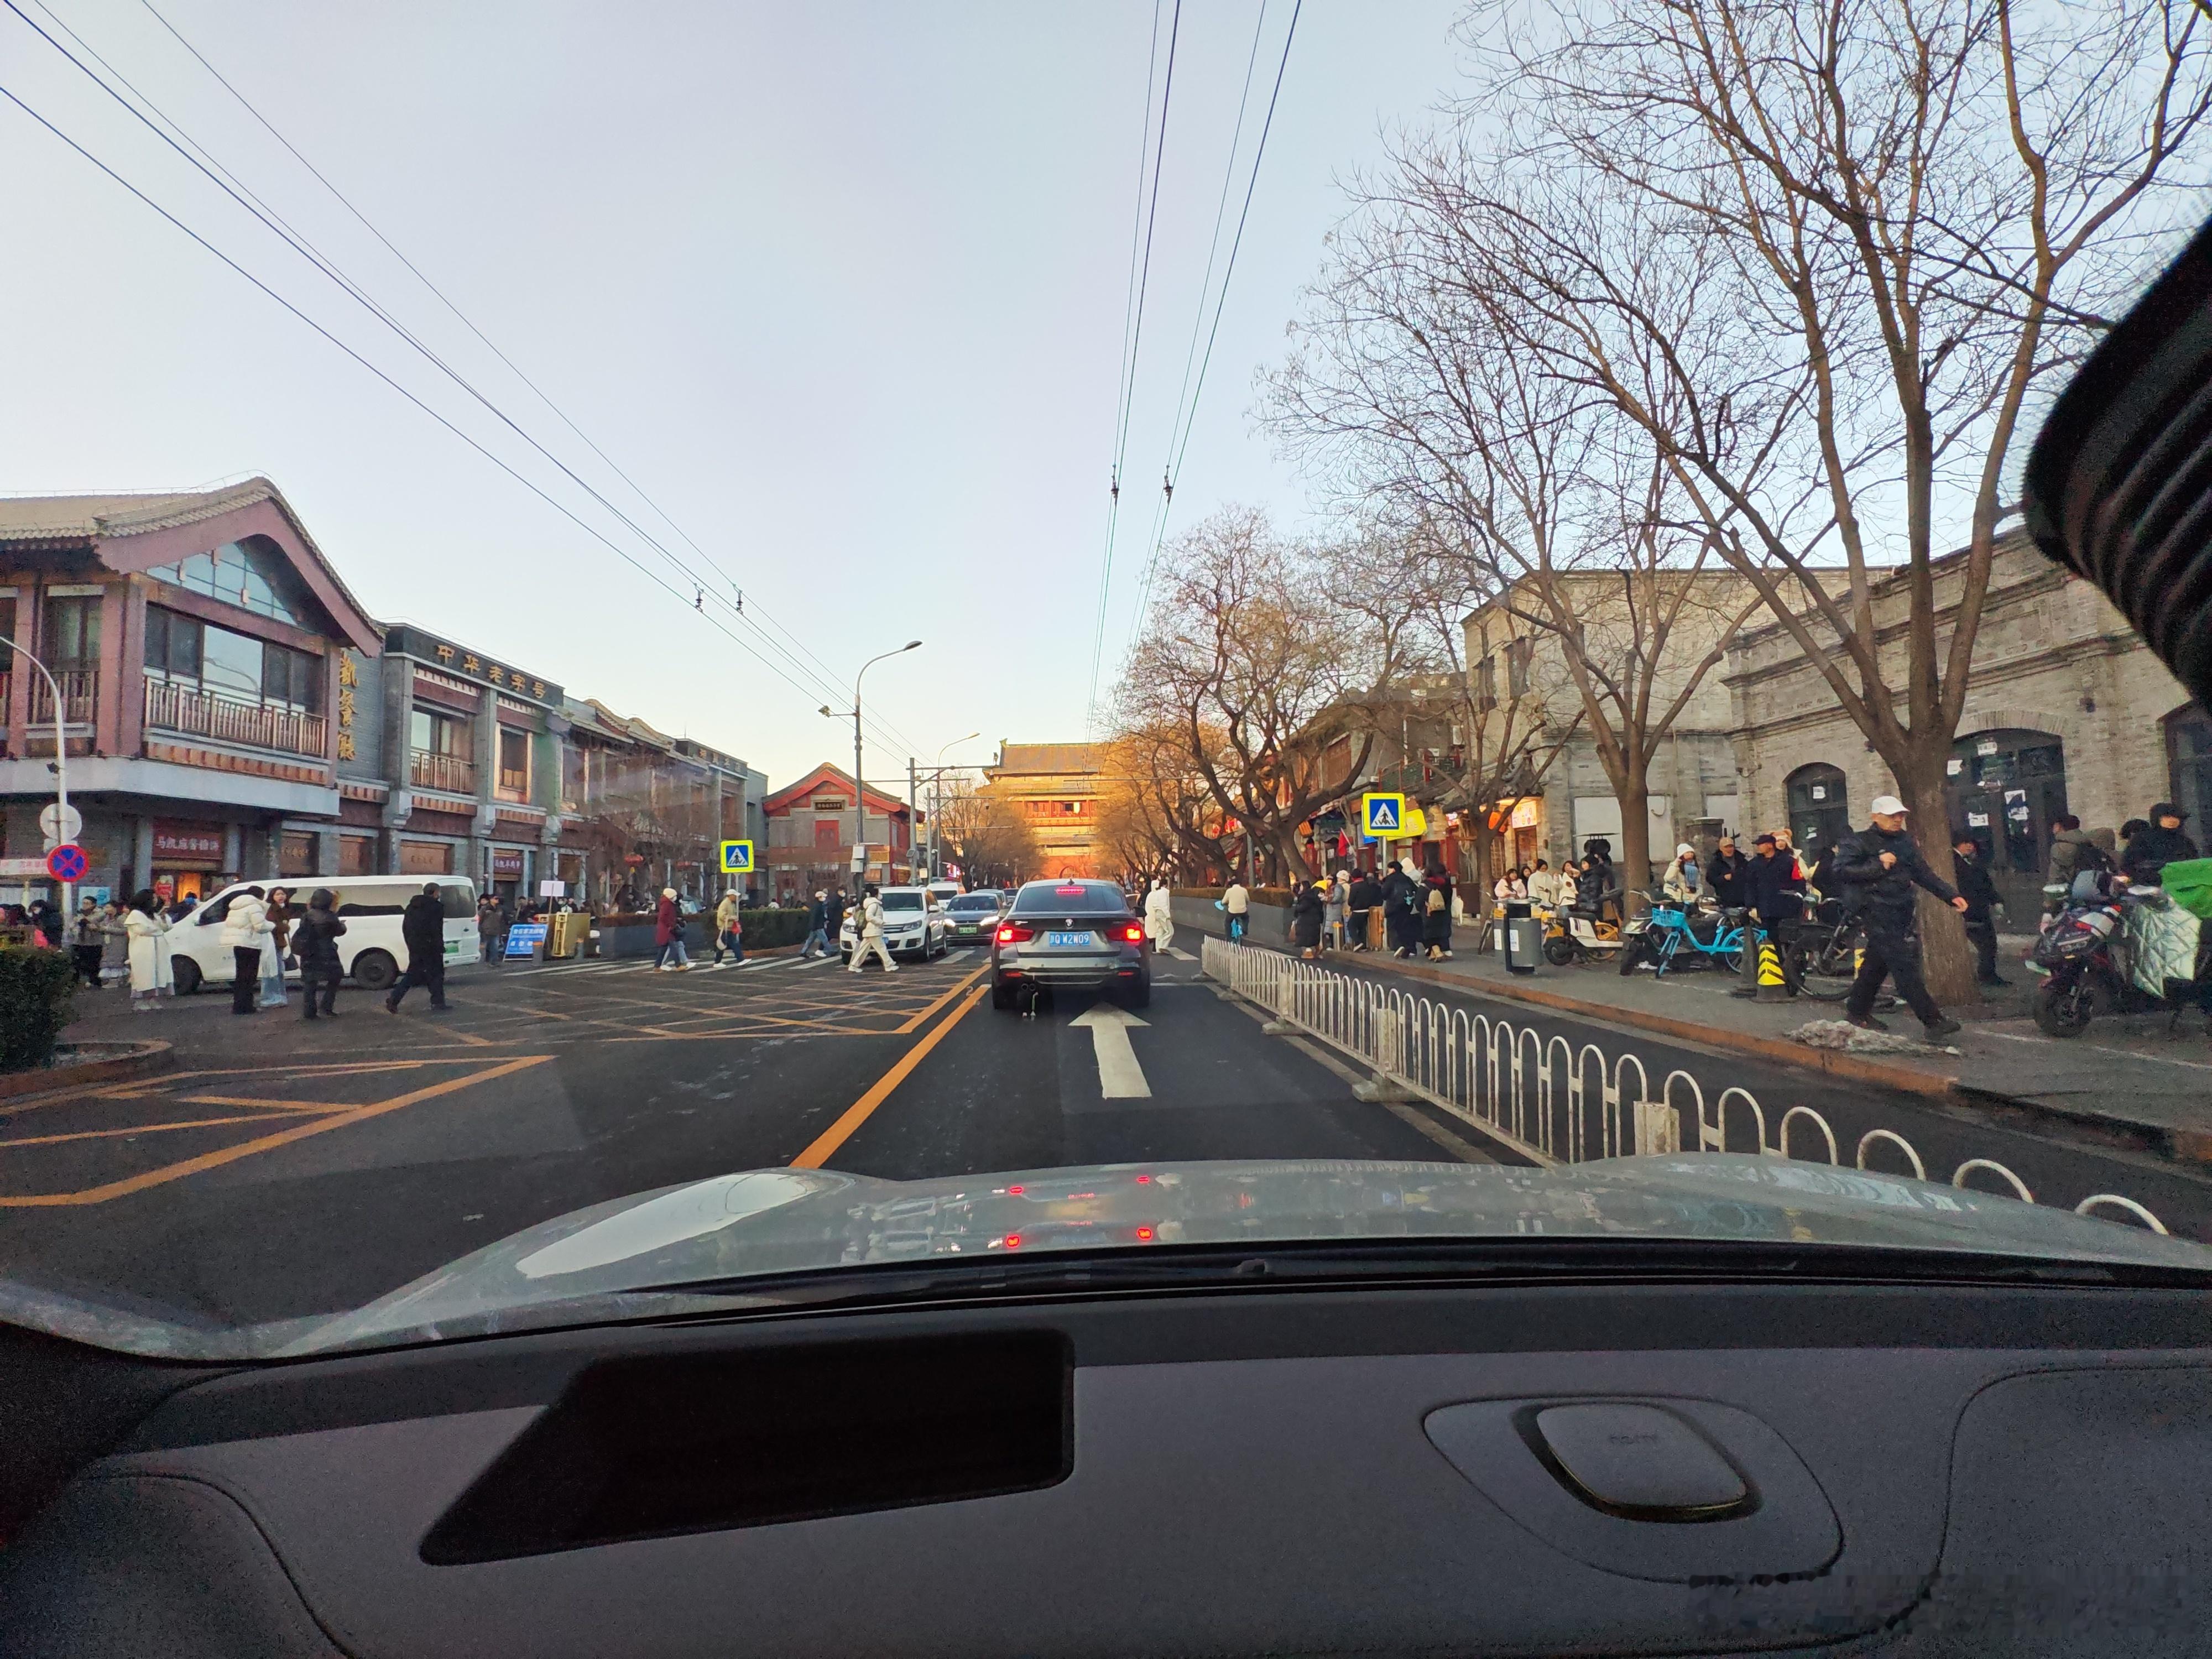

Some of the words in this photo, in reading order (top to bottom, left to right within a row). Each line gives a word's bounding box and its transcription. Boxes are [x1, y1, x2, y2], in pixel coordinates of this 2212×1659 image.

[437, 644, 546, 699] 中华老字号
